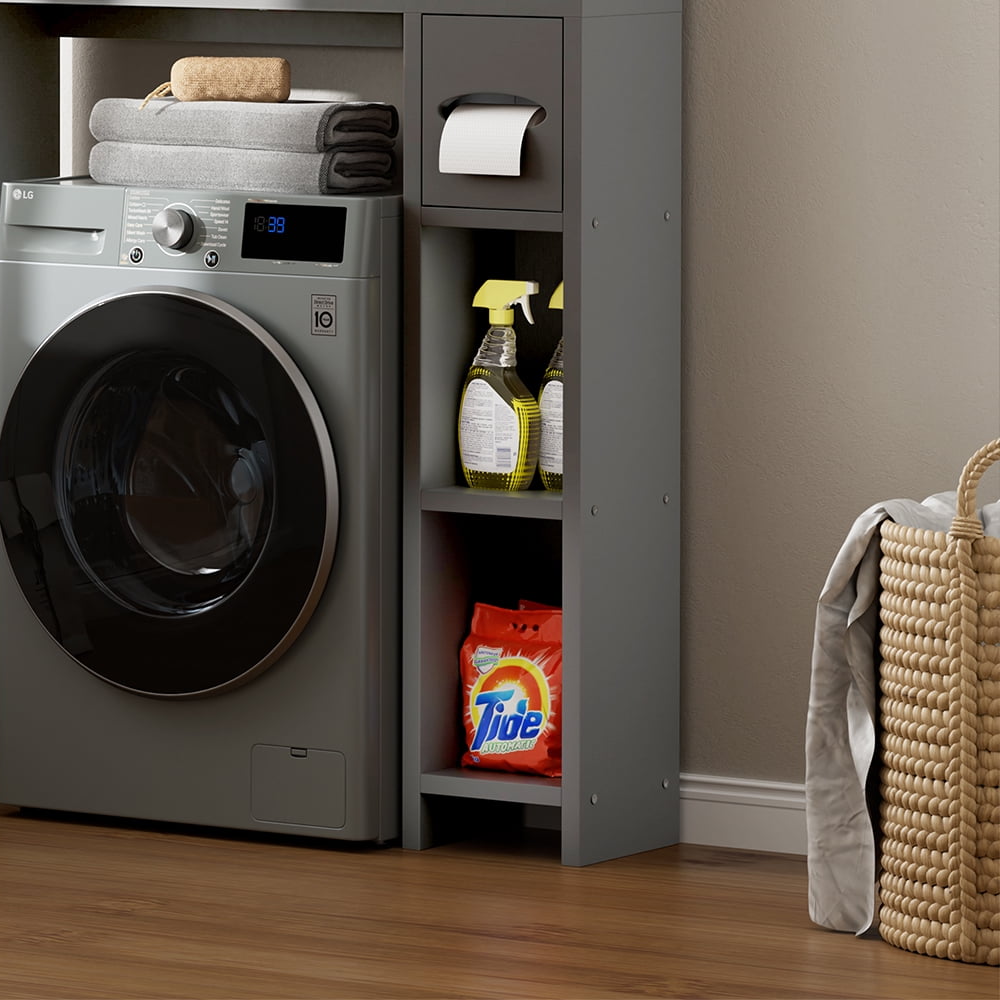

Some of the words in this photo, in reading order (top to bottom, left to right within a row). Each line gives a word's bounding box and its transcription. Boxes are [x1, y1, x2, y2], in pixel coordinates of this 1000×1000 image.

[22, 190, 34, 200] LG
[314, 311, 333, 328] 10
[470, 689, 543, 751] Tide
[481, 739, 537, 754] AUTOMATIC
